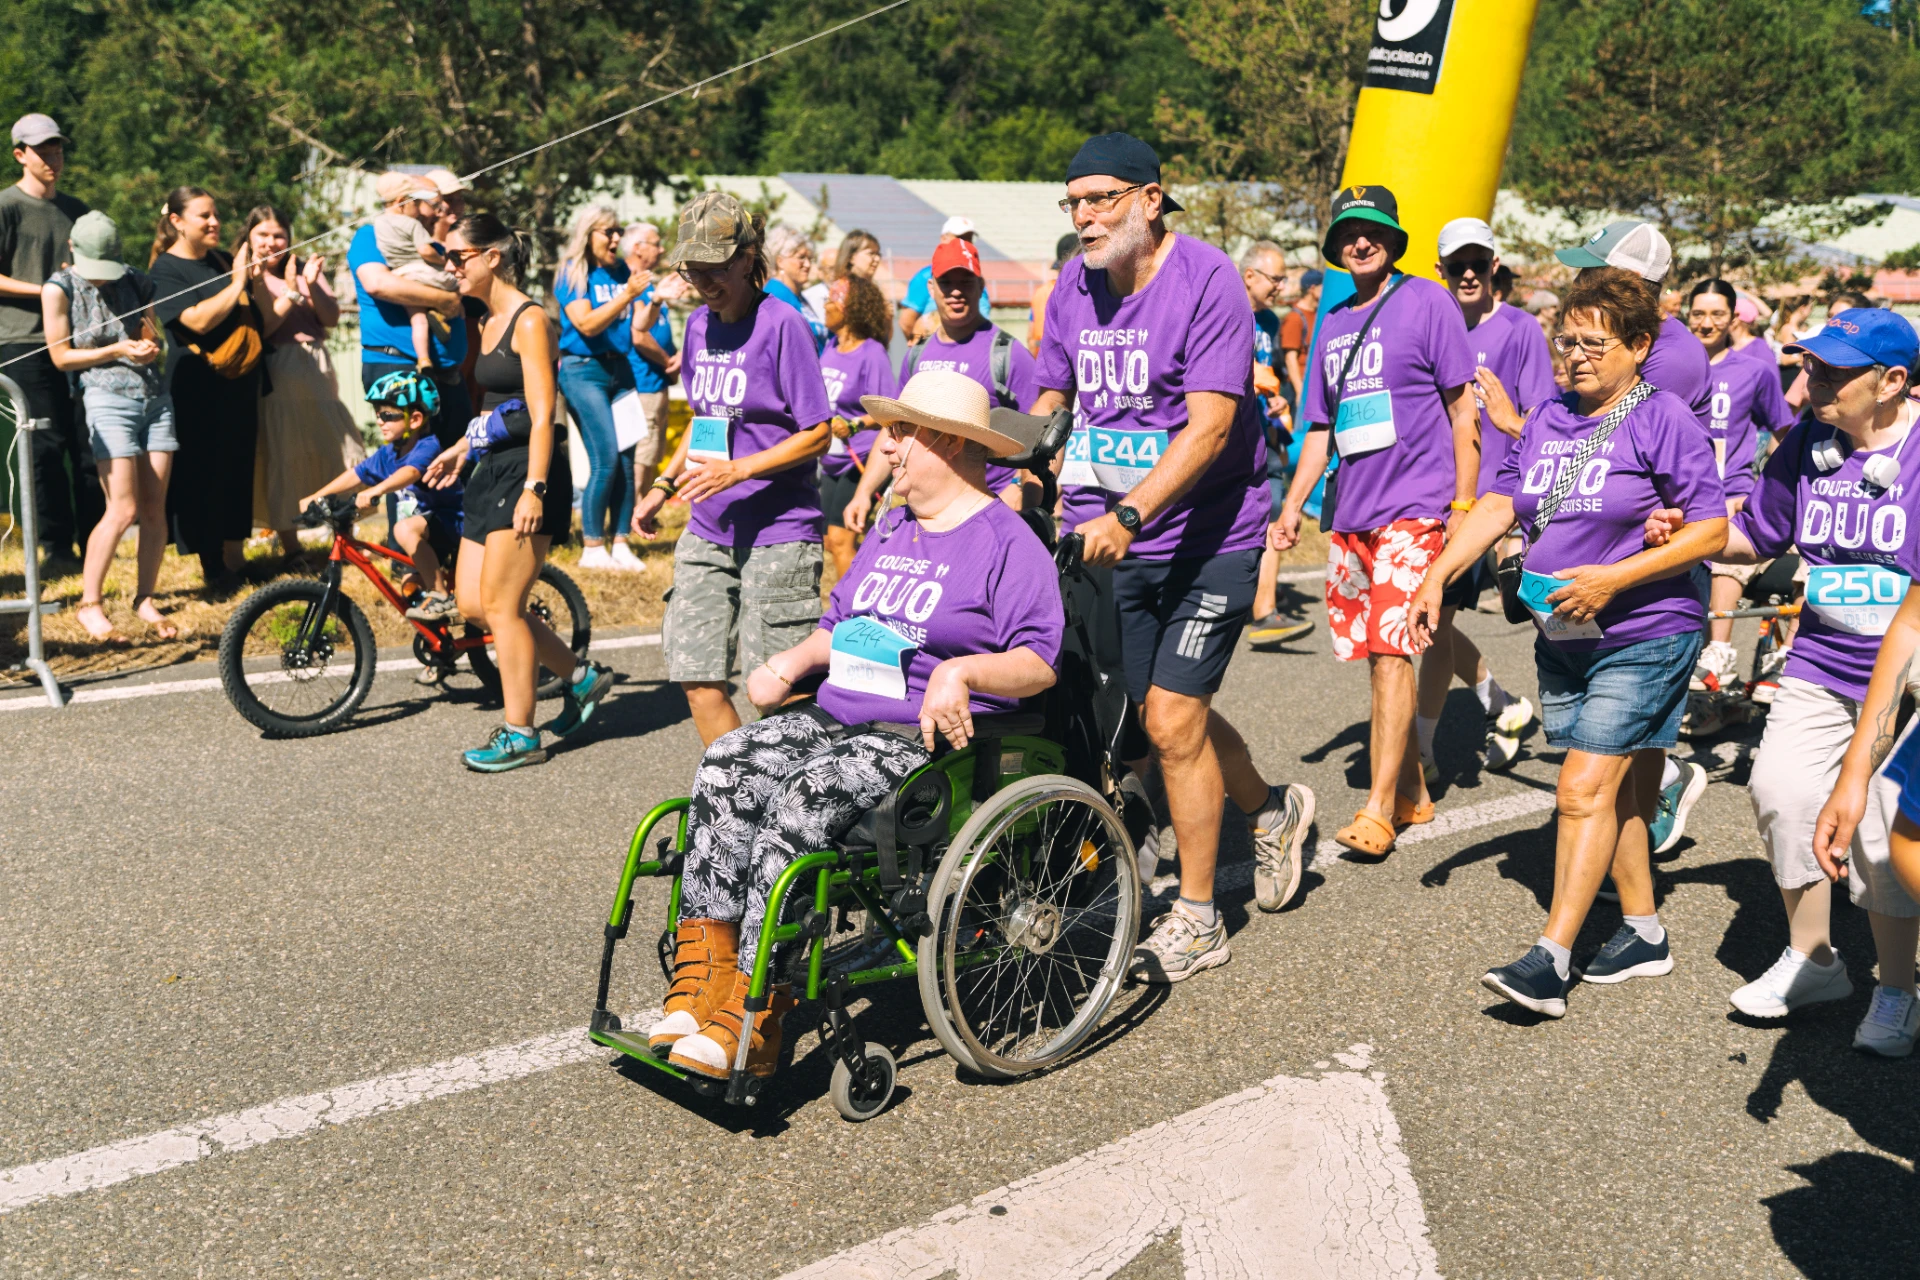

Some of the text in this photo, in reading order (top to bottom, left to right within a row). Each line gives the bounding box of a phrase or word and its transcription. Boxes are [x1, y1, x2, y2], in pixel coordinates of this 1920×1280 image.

[1341, 200, 1376, 210] GUINNESS
[1080, 328, 1136, 346] COURSE
[695, 348, 732, 364] COURSE
[1325, 341, 1383, 387] DUO
[918, 360, 956, 373] COURSE
[1077, 349, 1149, 394] DUO
[691, 365, 747, 406] DUO
[1346, 377, 1384, 392] SUISSE
[710, 404, 744, 418] SUISSE
[1113, 395, 1155, 410] SUISSE
[1340, 401, 1376, 425] 246
[695, 423, 715, 442] 244
[1096, 433, 1161, 466] 244
[1540, 438, 1587, 455] COURS
[1811, 478, 1877, 500] COURSE
[1559, 498, 1603, 513] SUISSE
[1800, 499, 1907, 552] DUO
[874, 555, 932, 575] COURSE
[1847, 551, 1898, 565] SUISS
[851, 571, 943, 623] DUO
[1818, 571, 1901, 604] 250
[1844, 612, 1879, 626] DUO
[844, 621, 886, 648] 244
